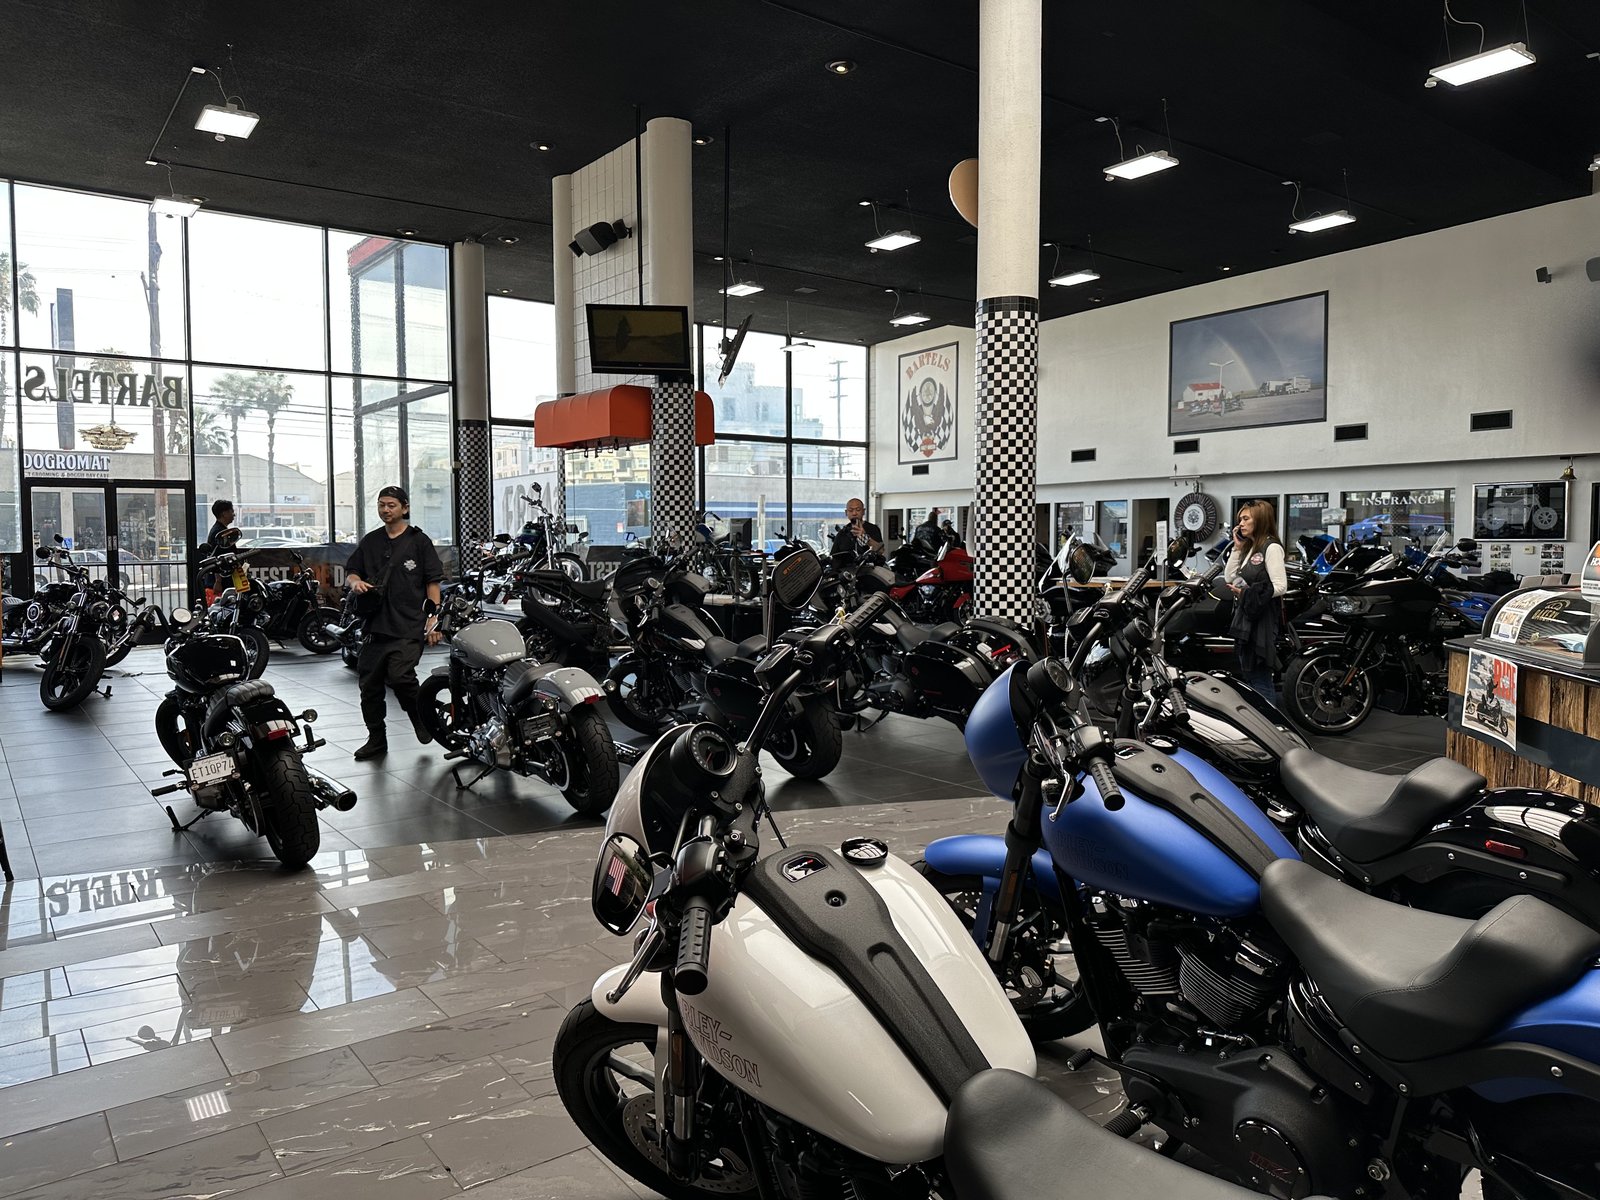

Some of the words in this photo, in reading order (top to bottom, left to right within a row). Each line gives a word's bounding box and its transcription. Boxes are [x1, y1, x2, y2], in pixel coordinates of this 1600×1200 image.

[905, 352, 951, 380] BARTELS
[23, 453, 111, 471] DOGROMAT
[1361, 495, 1436, 506] INSURANCE
[249, 566, 290, 582] TEST
[681, 998, 733, 1044] RLEY-
[696, 1034, 762, 1088] IDSON
